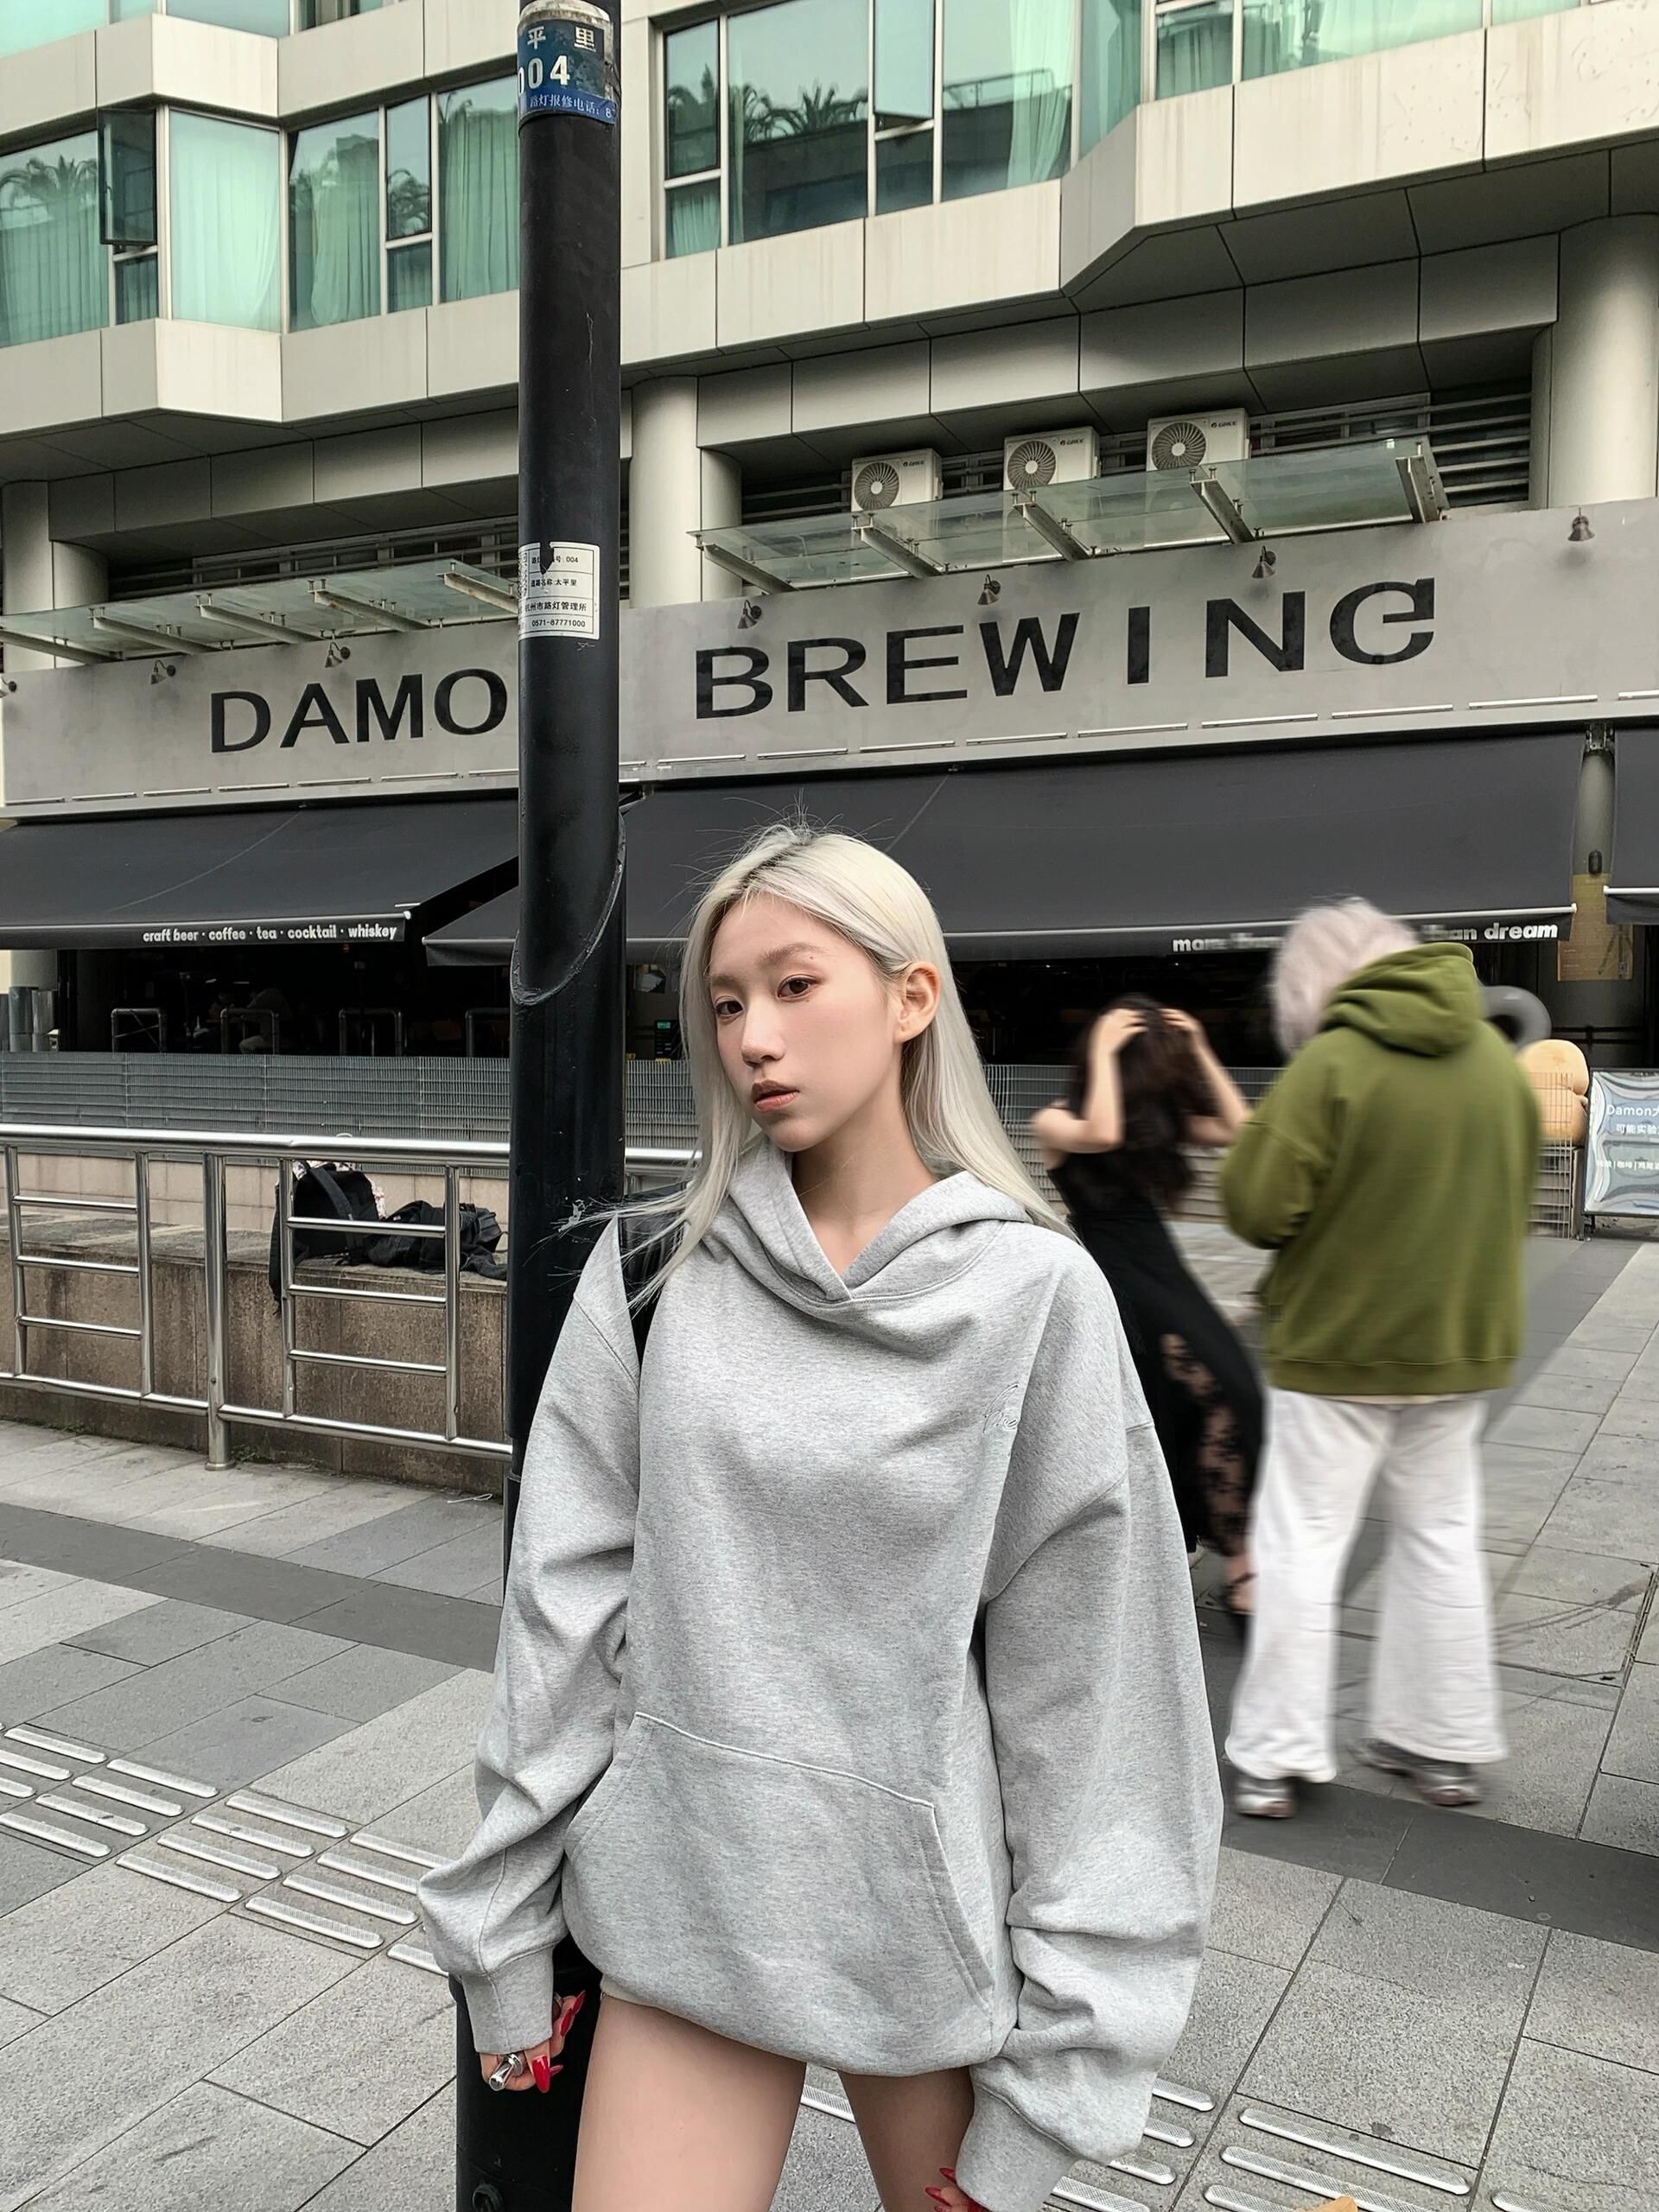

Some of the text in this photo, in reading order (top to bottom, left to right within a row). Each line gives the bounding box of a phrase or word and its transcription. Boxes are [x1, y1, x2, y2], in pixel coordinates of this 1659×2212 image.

[531, 619, 586, 627] 0571-87771000
[696, 577, 1435, 720] BREWING
[143, 923, 397, 942] craft beer coffee tea cocktail whiskey
[1484, 922, 1558, 940] dream
